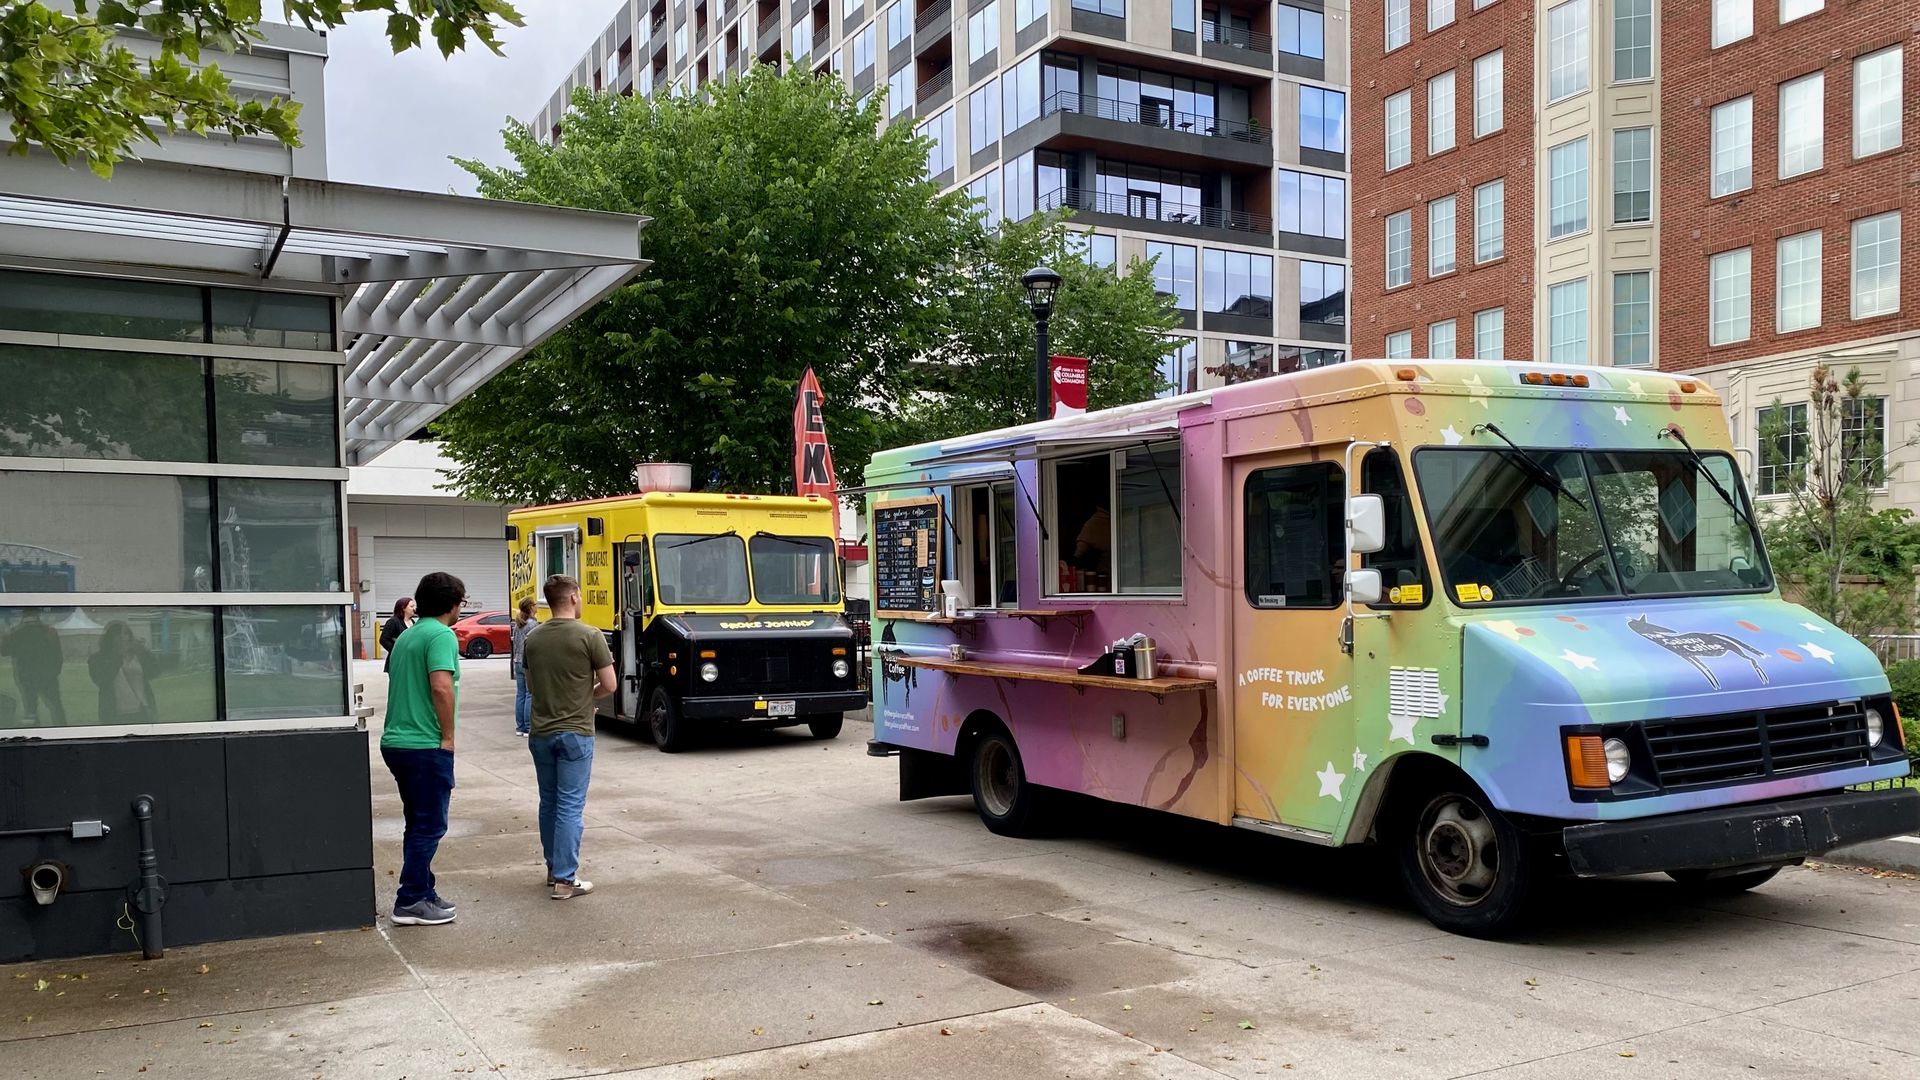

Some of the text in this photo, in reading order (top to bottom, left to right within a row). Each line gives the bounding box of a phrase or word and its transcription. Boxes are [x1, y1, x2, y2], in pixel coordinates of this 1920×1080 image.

[512, 545, 531, 571] BROKE
[512, 562, 534, 592] JOHNNY
[586, 590, 596, 604] LATE
[720, 620, 815, 630] BROKE JOHNNY
[1662, 638, 1706, 646] Galaxy
[1683, 644, 1725, 652] Coffee
[889, 663, 905, 675] Coffee
[1239, 668, 1326, 686] A COFFEE TRUCK
[1262, 684, 1352, 712] FOR EVERYONE
